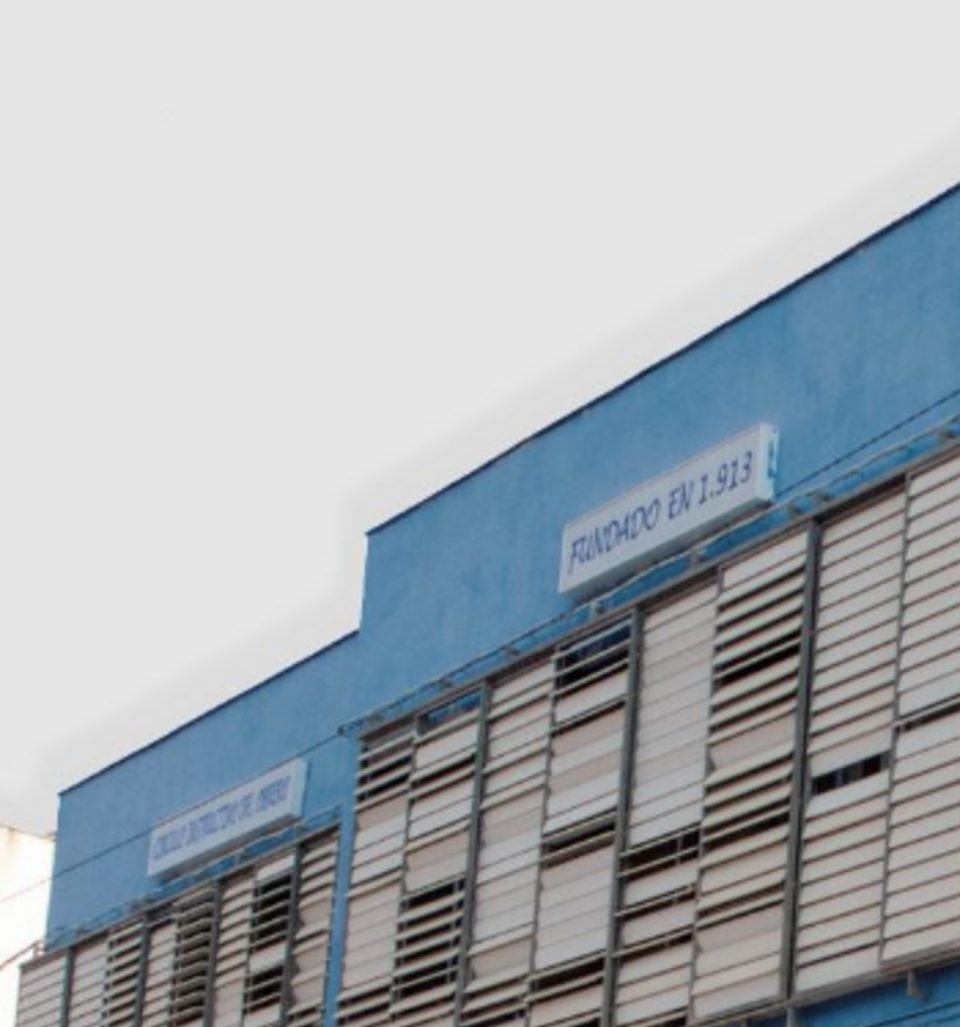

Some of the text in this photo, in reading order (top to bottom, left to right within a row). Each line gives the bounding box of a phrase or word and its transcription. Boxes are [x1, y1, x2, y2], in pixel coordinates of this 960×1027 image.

[569, 451, 753, 575] FUNDADO EN 1.913
